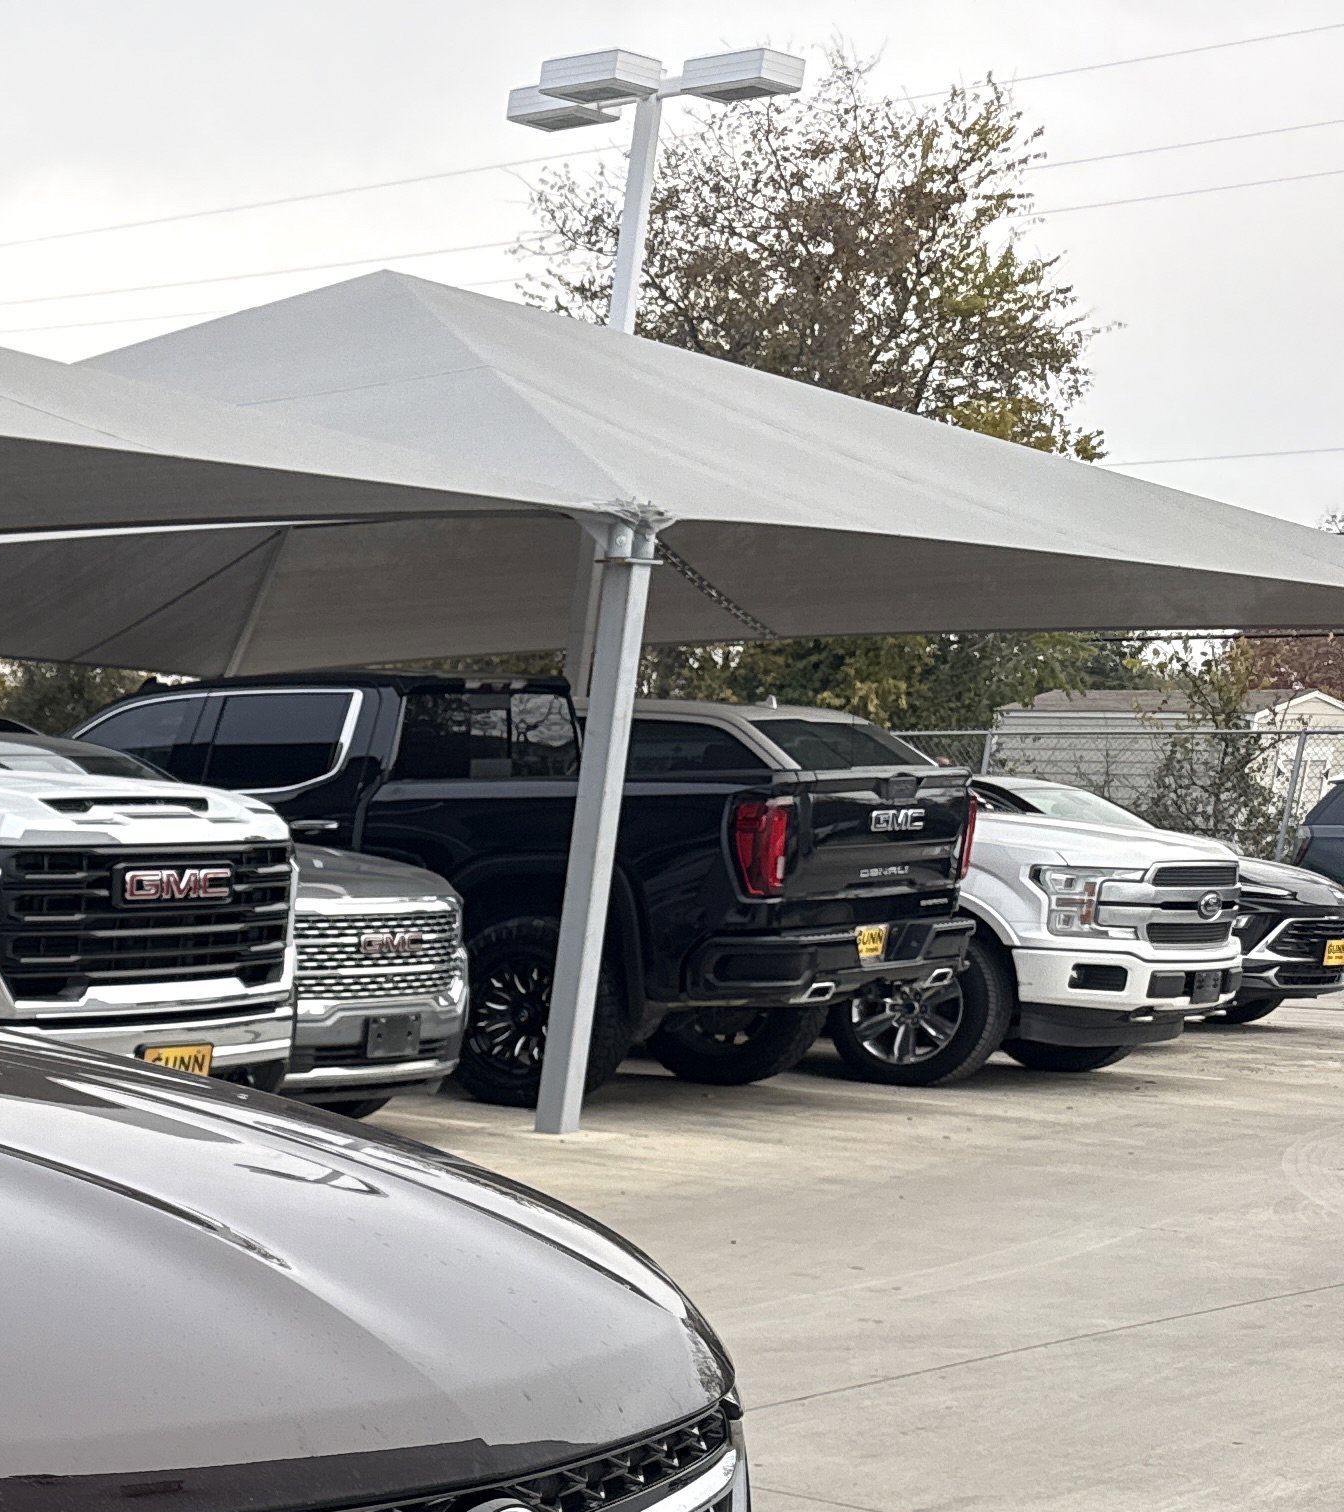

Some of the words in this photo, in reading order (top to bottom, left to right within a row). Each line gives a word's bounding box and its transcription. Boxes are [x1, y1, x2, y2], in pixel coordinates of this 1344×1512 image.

[871, 808, 926, 832] GMC
[859, 865, 910, 878] DENALI
[125, 868, 231, 900] GMC
[360, 932, 423, 954] GMC
